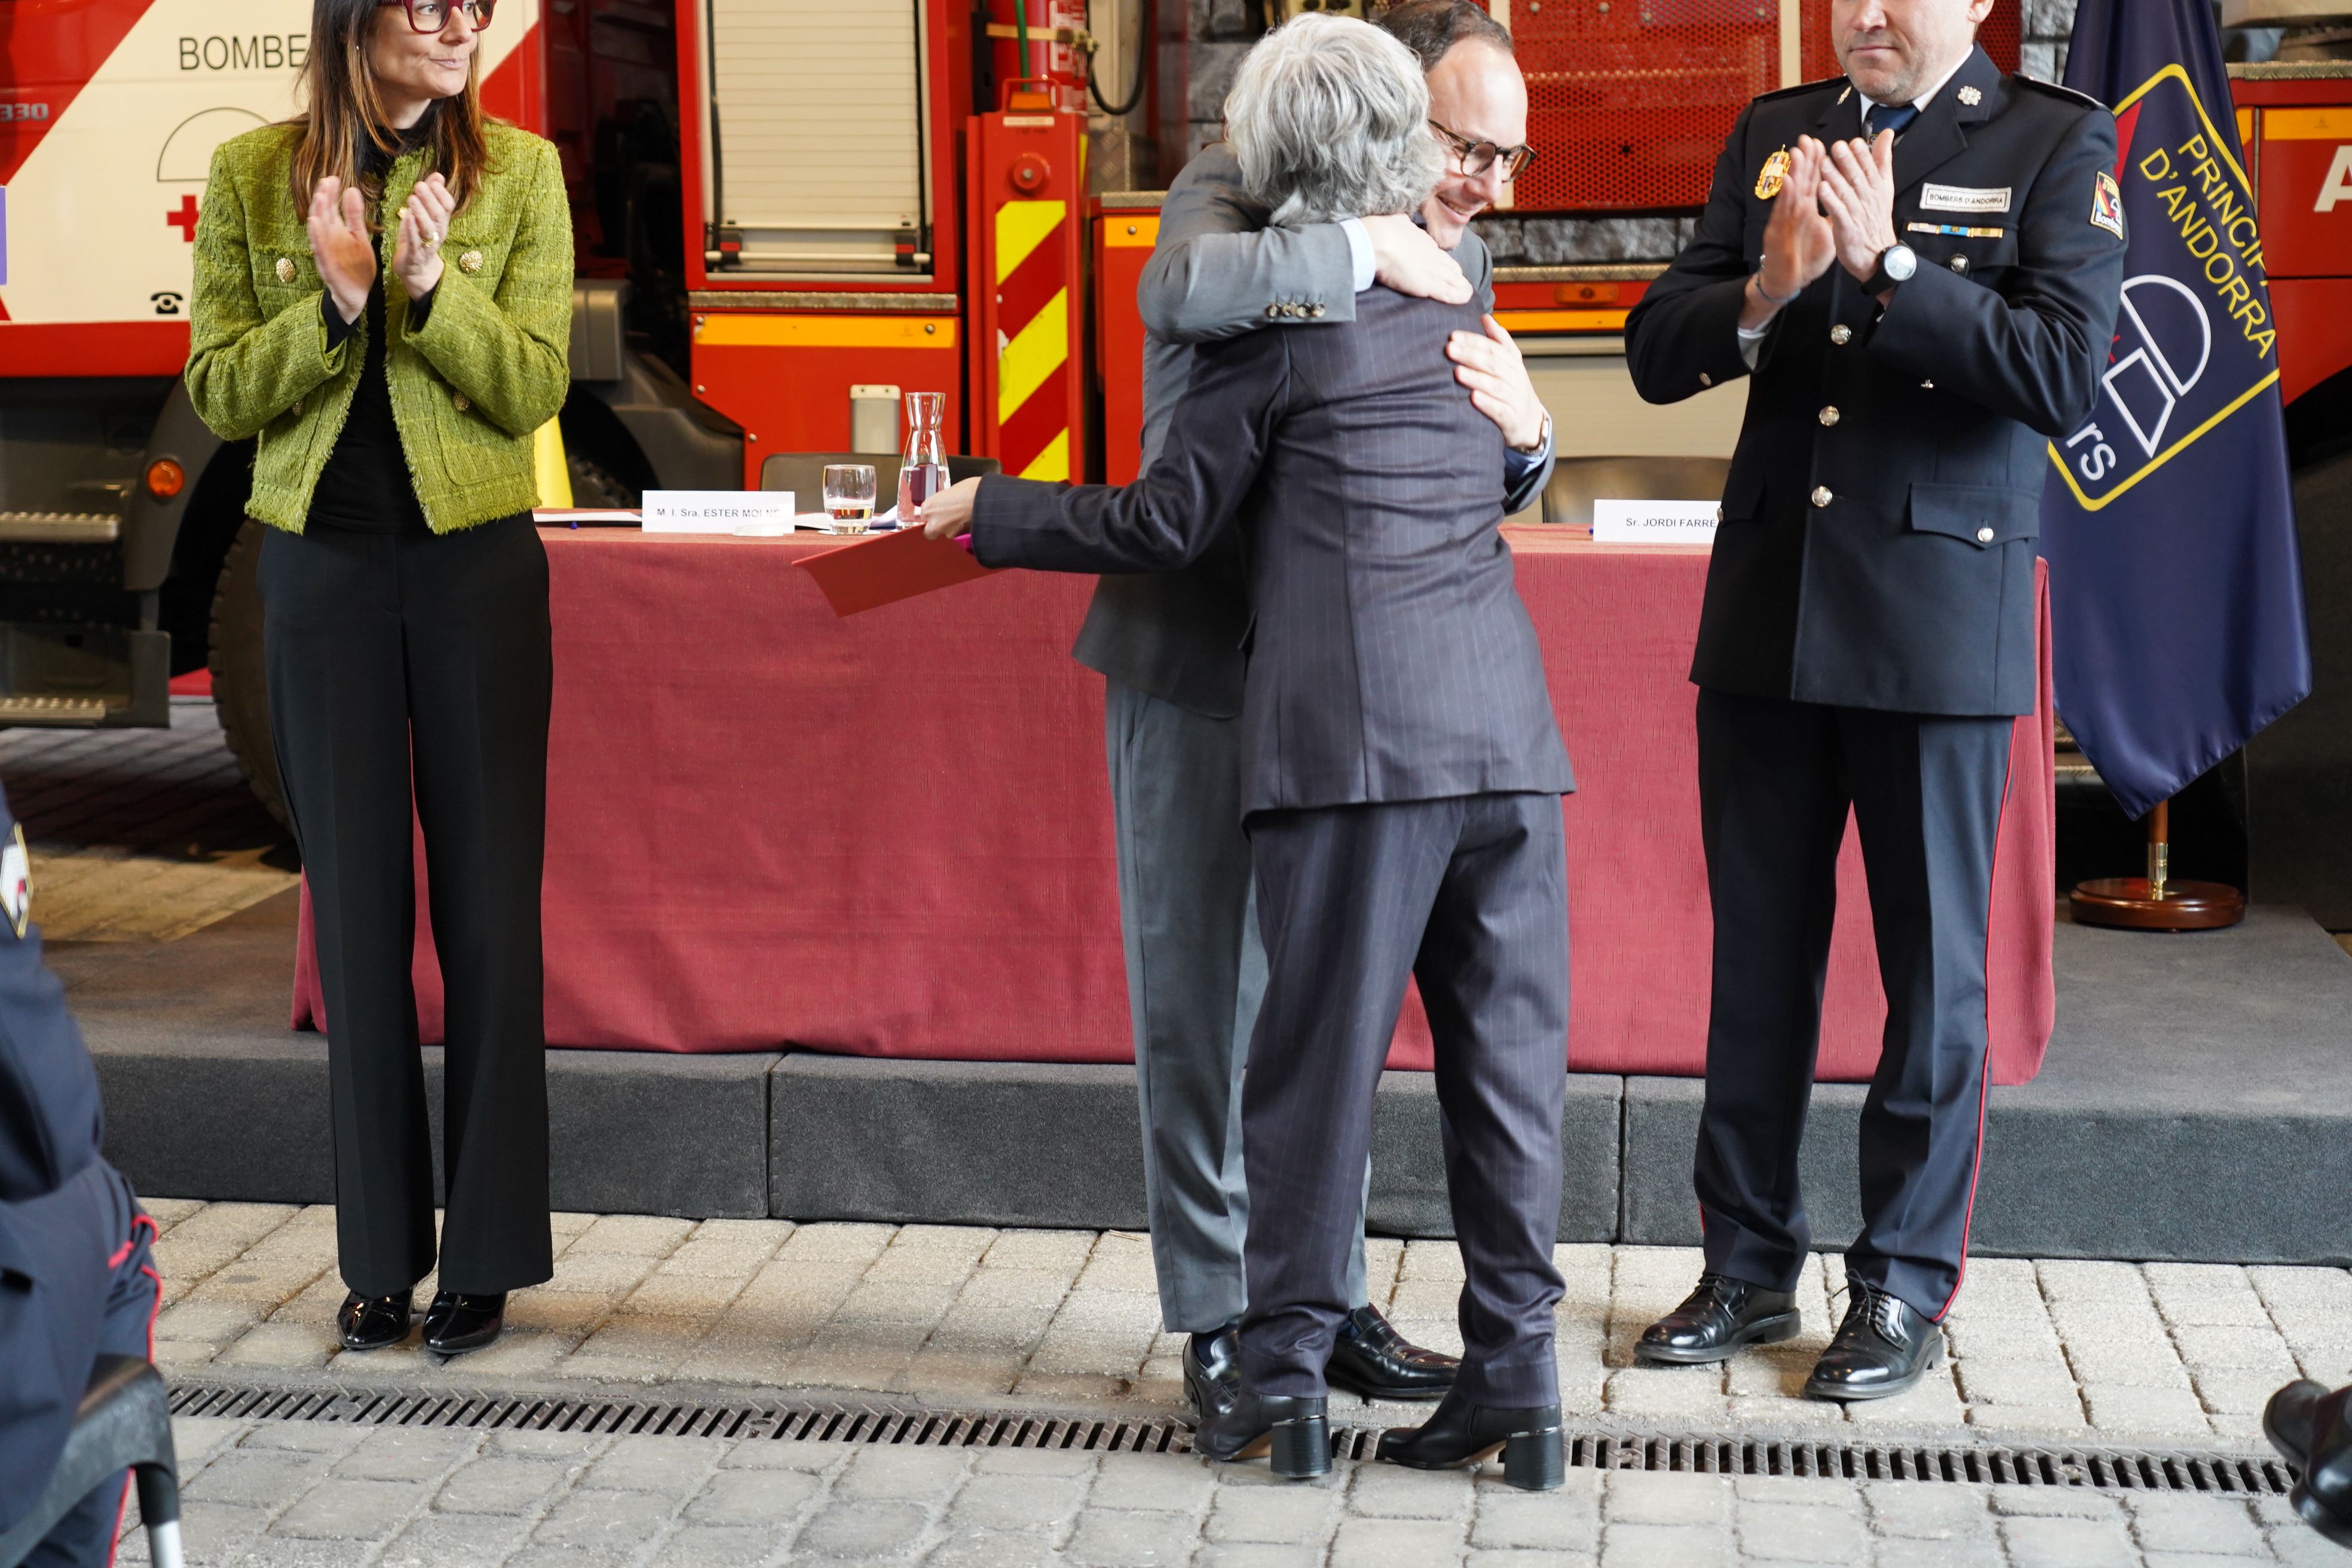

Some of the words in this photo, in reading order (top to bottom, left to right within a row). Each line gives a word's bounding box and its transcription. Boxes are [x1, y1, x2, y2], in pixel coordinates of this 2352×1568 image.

[1930, 194, 1963, 203] BOMBERS
[2139, 148, 2276, 359] D'ANDORRA
[657, 509, 668, 517] M.
[704, 509, 739, 517] ESTER
[1626, 518, 1640, 526] Sr.
[1643, 519, 1676, 527] JORDI
